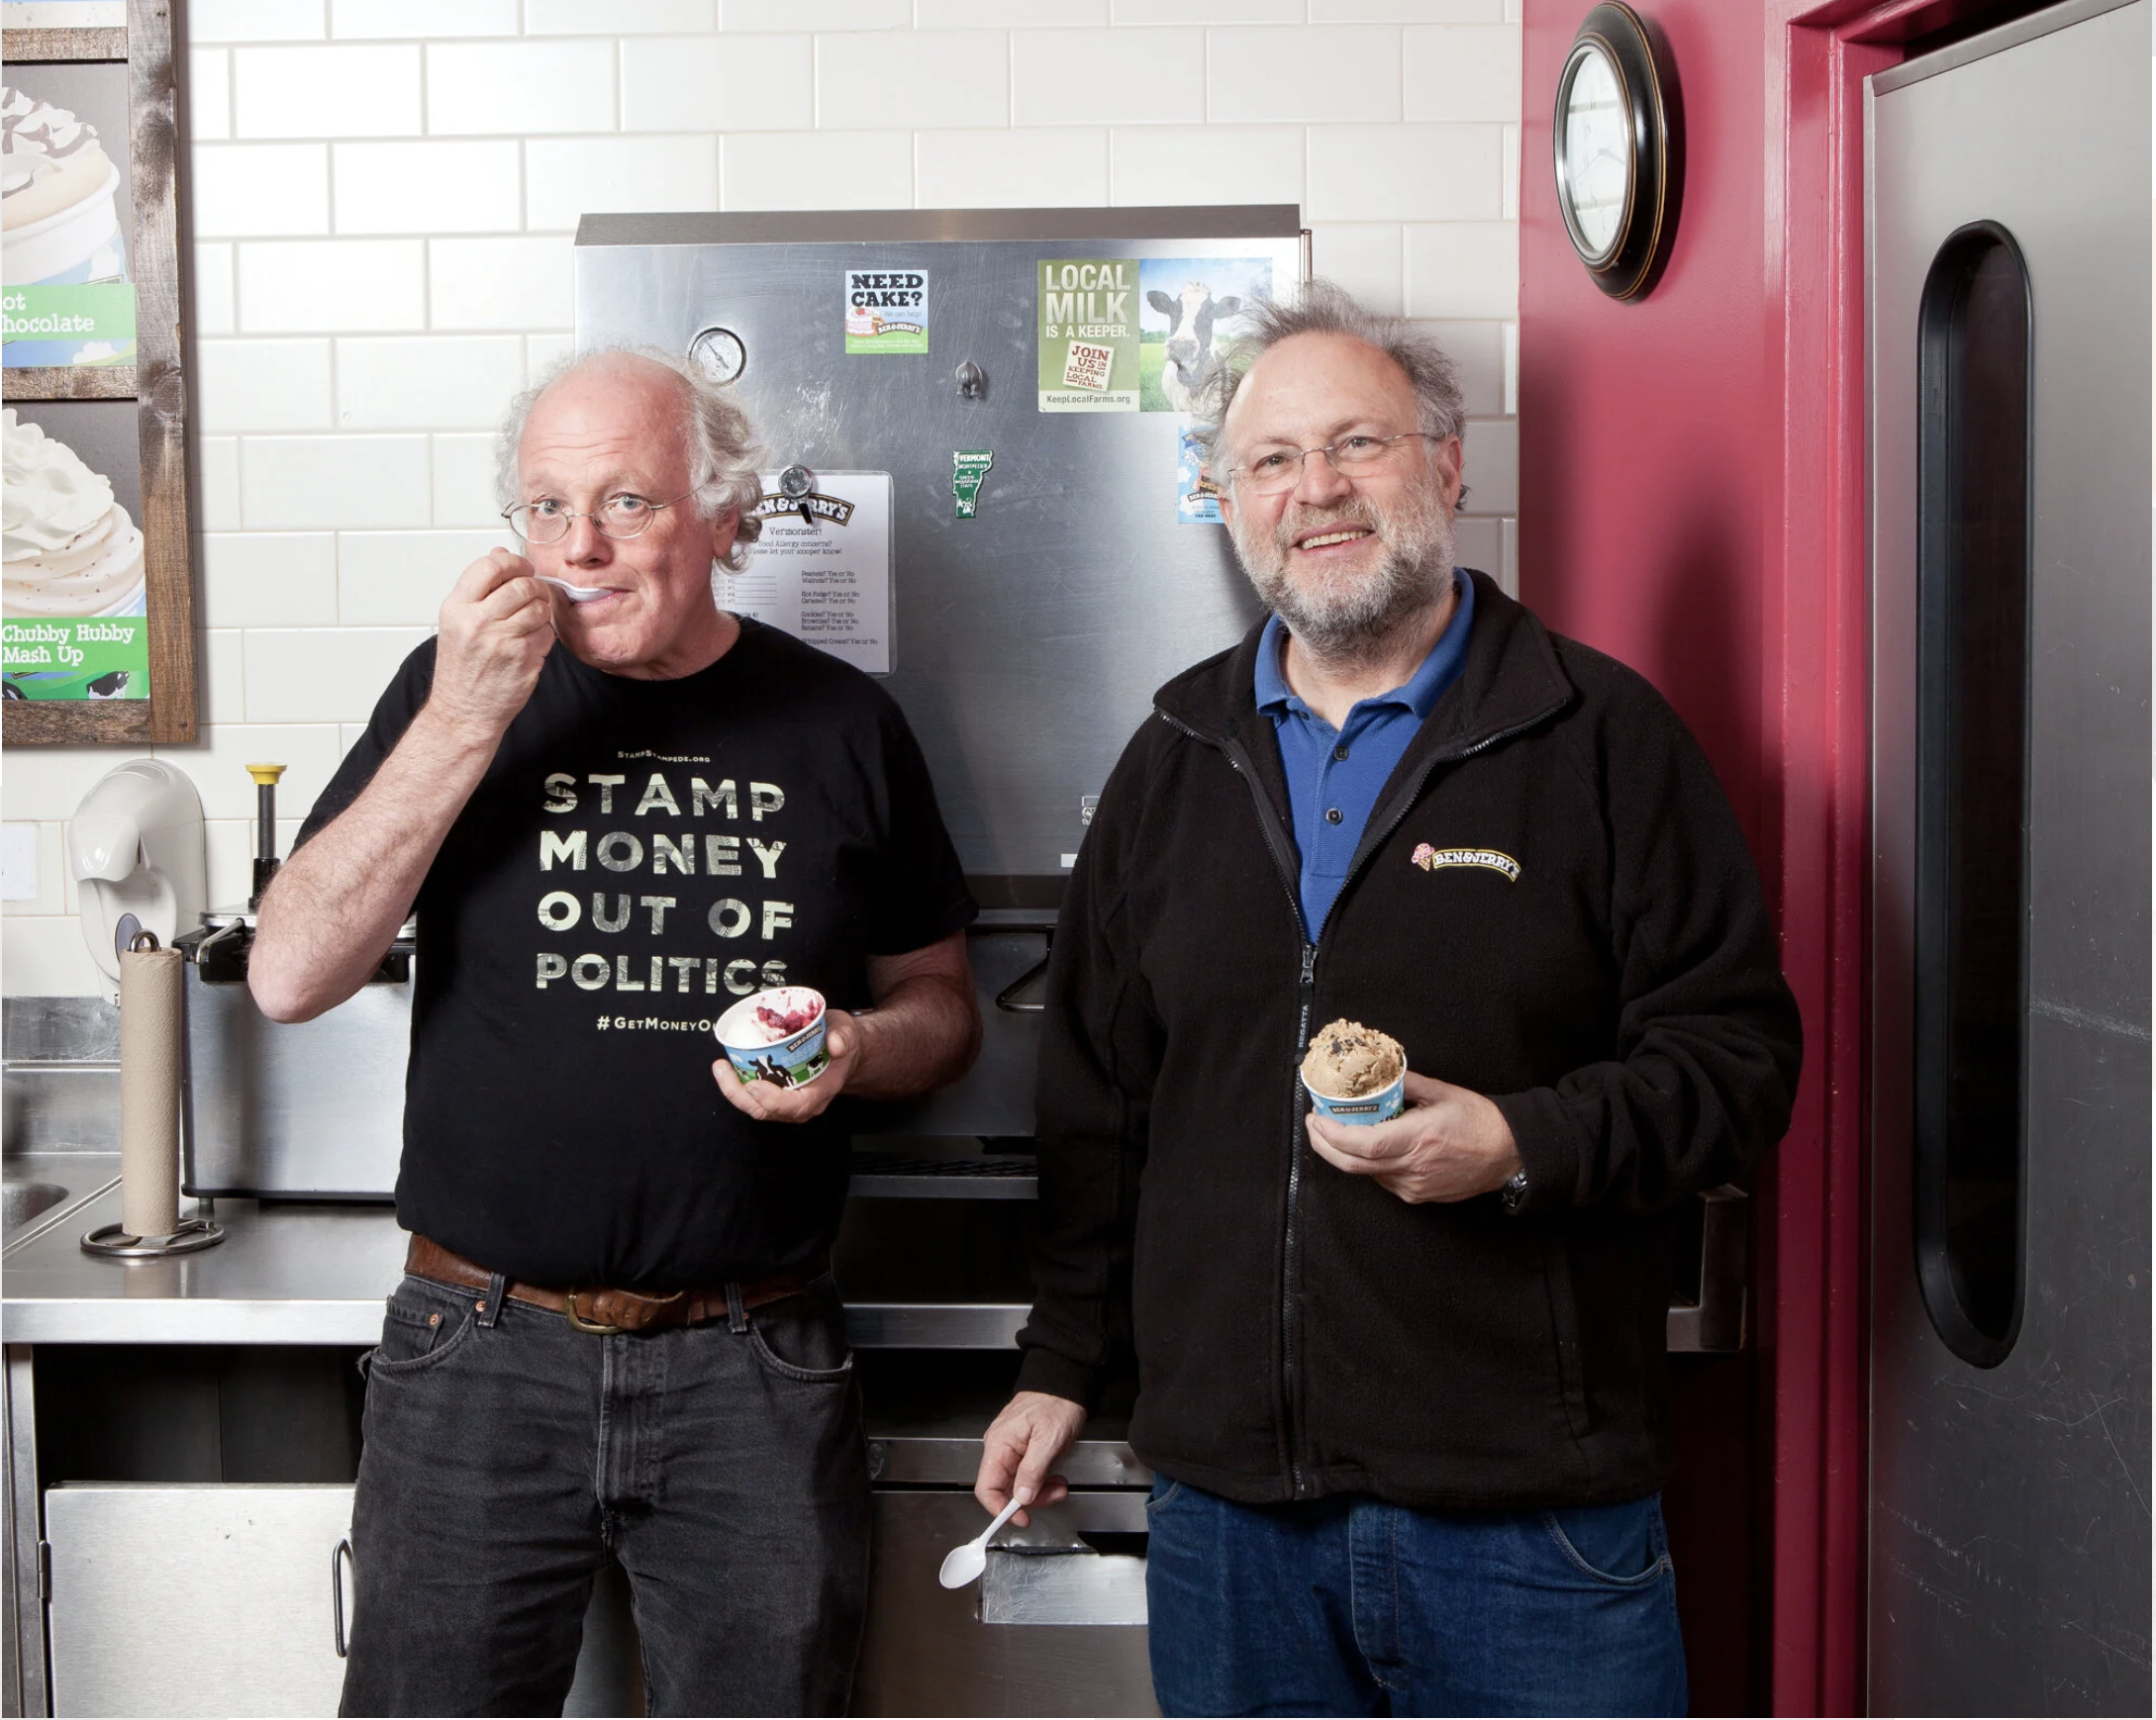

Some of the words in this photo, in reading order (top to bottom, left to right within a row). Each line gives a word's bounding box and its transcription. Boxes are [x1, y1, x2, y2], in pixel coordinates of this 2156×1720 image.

[851, 274, 924, 289] NEED
[1046, 264, 1130, 291] LOCAL
[2, 293, 27, 311] ot
[850, 291, 923, 307] CAKE?
[1046, 292, 1128, 324] MILK
[2, 314, 95, 333] hocolate
[1046, 325, 1058, 337] IS
[1065, 325, 1075, 337] A
[1078, 325, 1130, 337] KEEPER.
[1071, 345, 1110, 361] JOIN
[1077, 357, 1097, 369] US
[1066, 372, 1097, 383] LOCAL
[1067, 365, 1106, 377] KEEPING
[1046, 395, 1130, 404] KeepLocalFarms.org
[2, 624, 71, 644] Chubby
[76, 623, 136, 644] Hubby
[3, 646, 51, 663] Mash
[57, 646, 84, 667] Up
[542, 772, 785, 821] STAMP
[539, 830, 787, 879] MONEY
[1434, 851, 1520, 878] BEN&JERRY'S
[538, 891, 677, 935] OUT
[708, 898, 794, 940] OF
[536, 953, 788, 995] POLITICS
[1298, 1004, 1309, 1048] REGATTA
